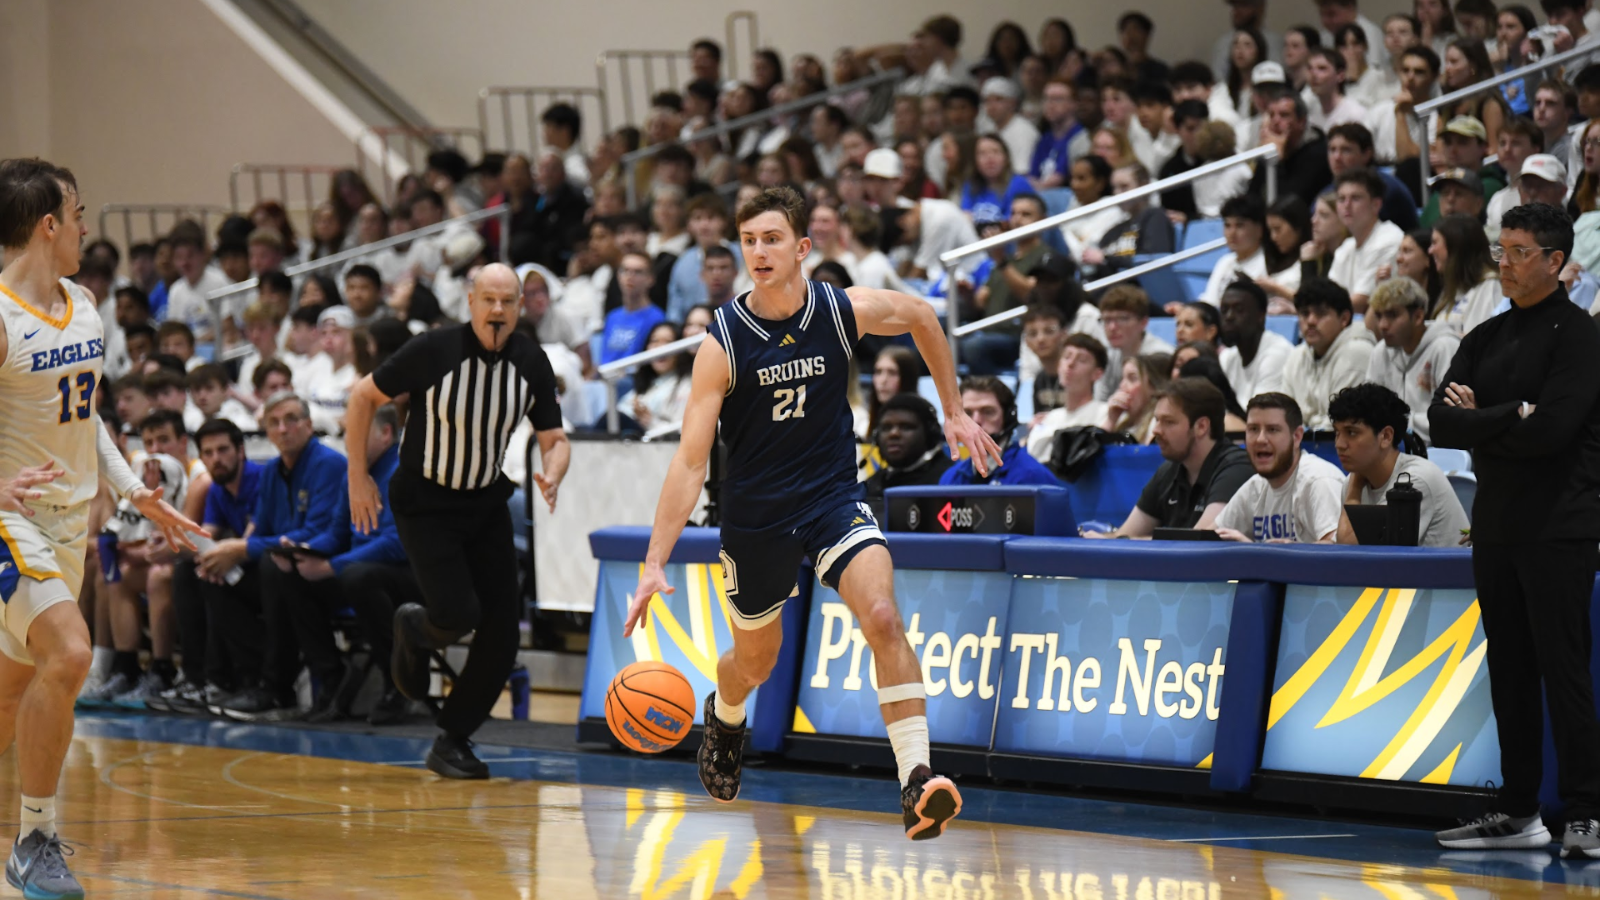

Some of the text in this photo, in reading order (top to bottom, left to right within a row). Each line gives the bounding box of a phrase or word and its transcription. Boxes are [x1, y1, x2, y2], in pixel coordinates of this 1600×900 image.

[30, 337, 104, 372] EAGLES
[756, 355, 826, 386] BRUINS
[58, 368, 96, 426] 13
[772, 384, 807, 422] 21
[950, 507, 973, 528] POSS
[1005, 510, 1013, 524] B
[810, 602, 1226, 721] Prtect The Nest
[644, 706, 685, 735] NCAA
